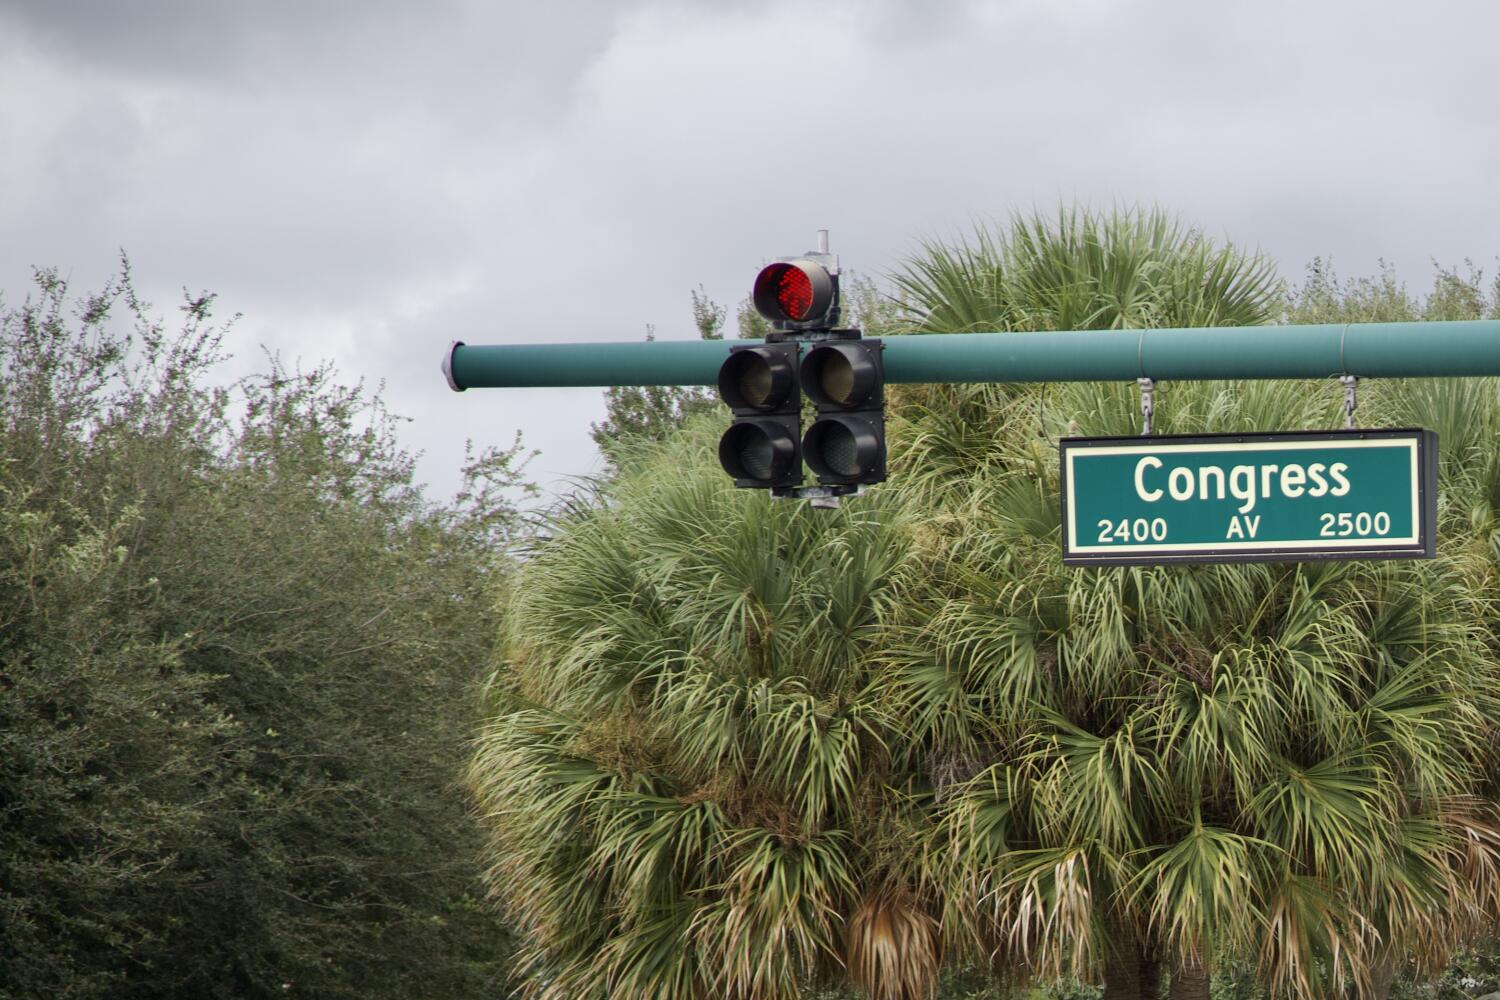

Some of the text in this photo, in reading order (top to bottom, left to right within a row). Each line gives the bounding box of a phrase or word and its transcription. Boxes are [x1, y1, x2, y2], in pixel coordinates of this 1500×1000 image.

[1134, 456, 1351, 515] Congress
[1097, 511, 1391, 543] 2400 AV 2500
